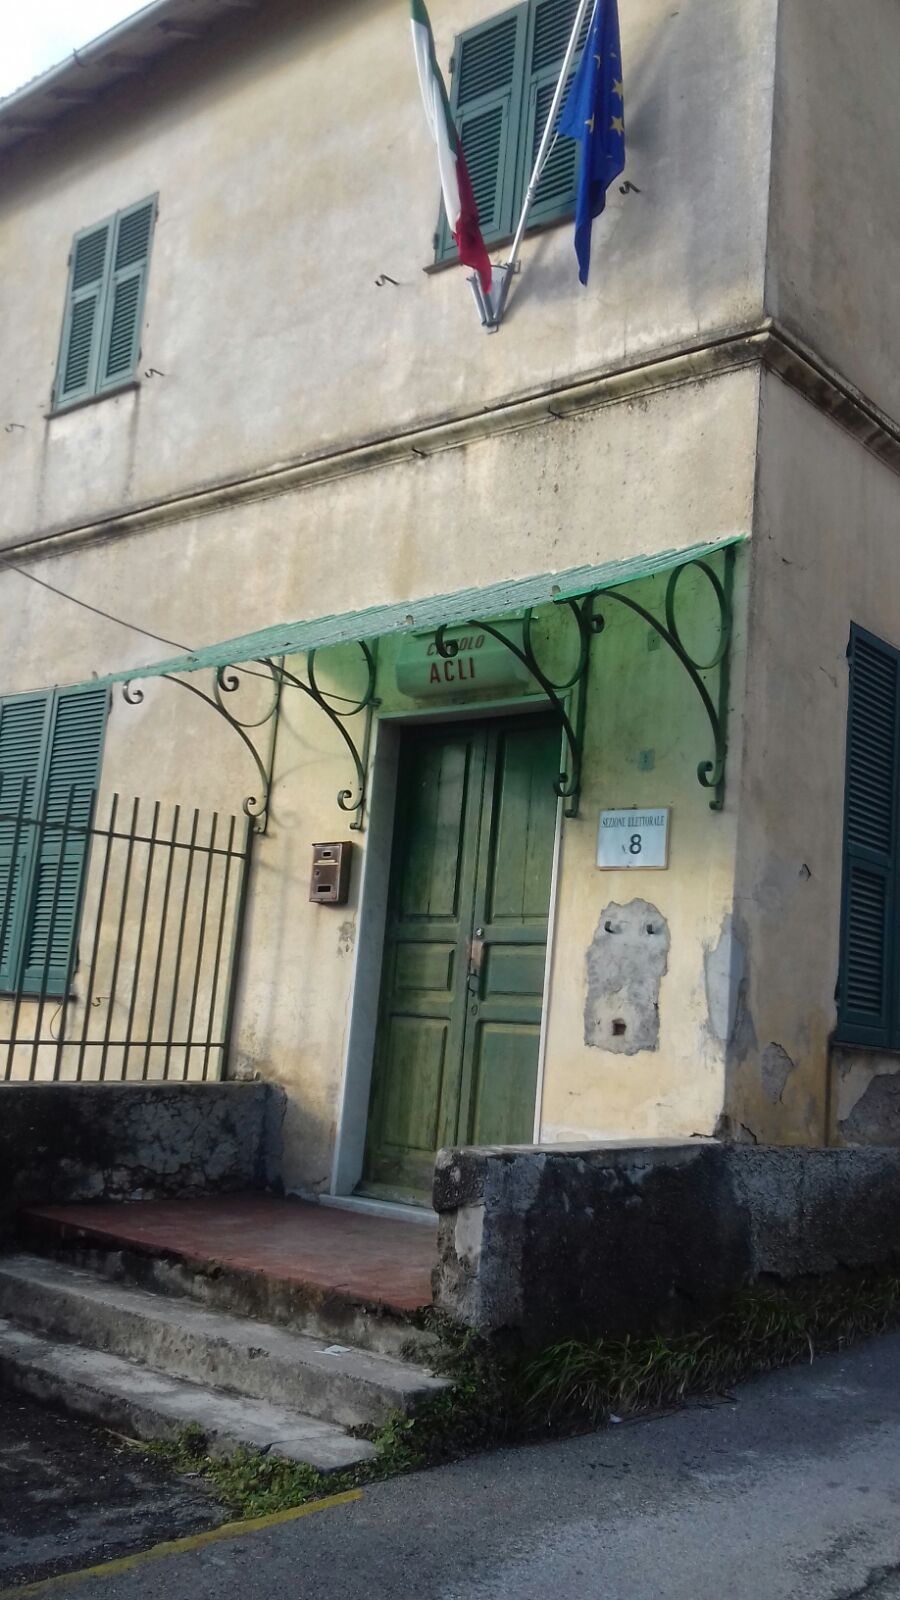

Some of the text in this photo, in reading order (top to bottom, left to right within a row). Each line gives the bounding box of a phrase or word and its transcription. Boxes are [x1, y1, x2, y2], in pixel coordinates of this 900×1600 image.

[427, 634, 486, 656] COLO
[430, 656, 476, 684] ACLI
[602, 815, 665, 828] SEZIONE ELETTORALE
[629, 833, 642, 855] 8
